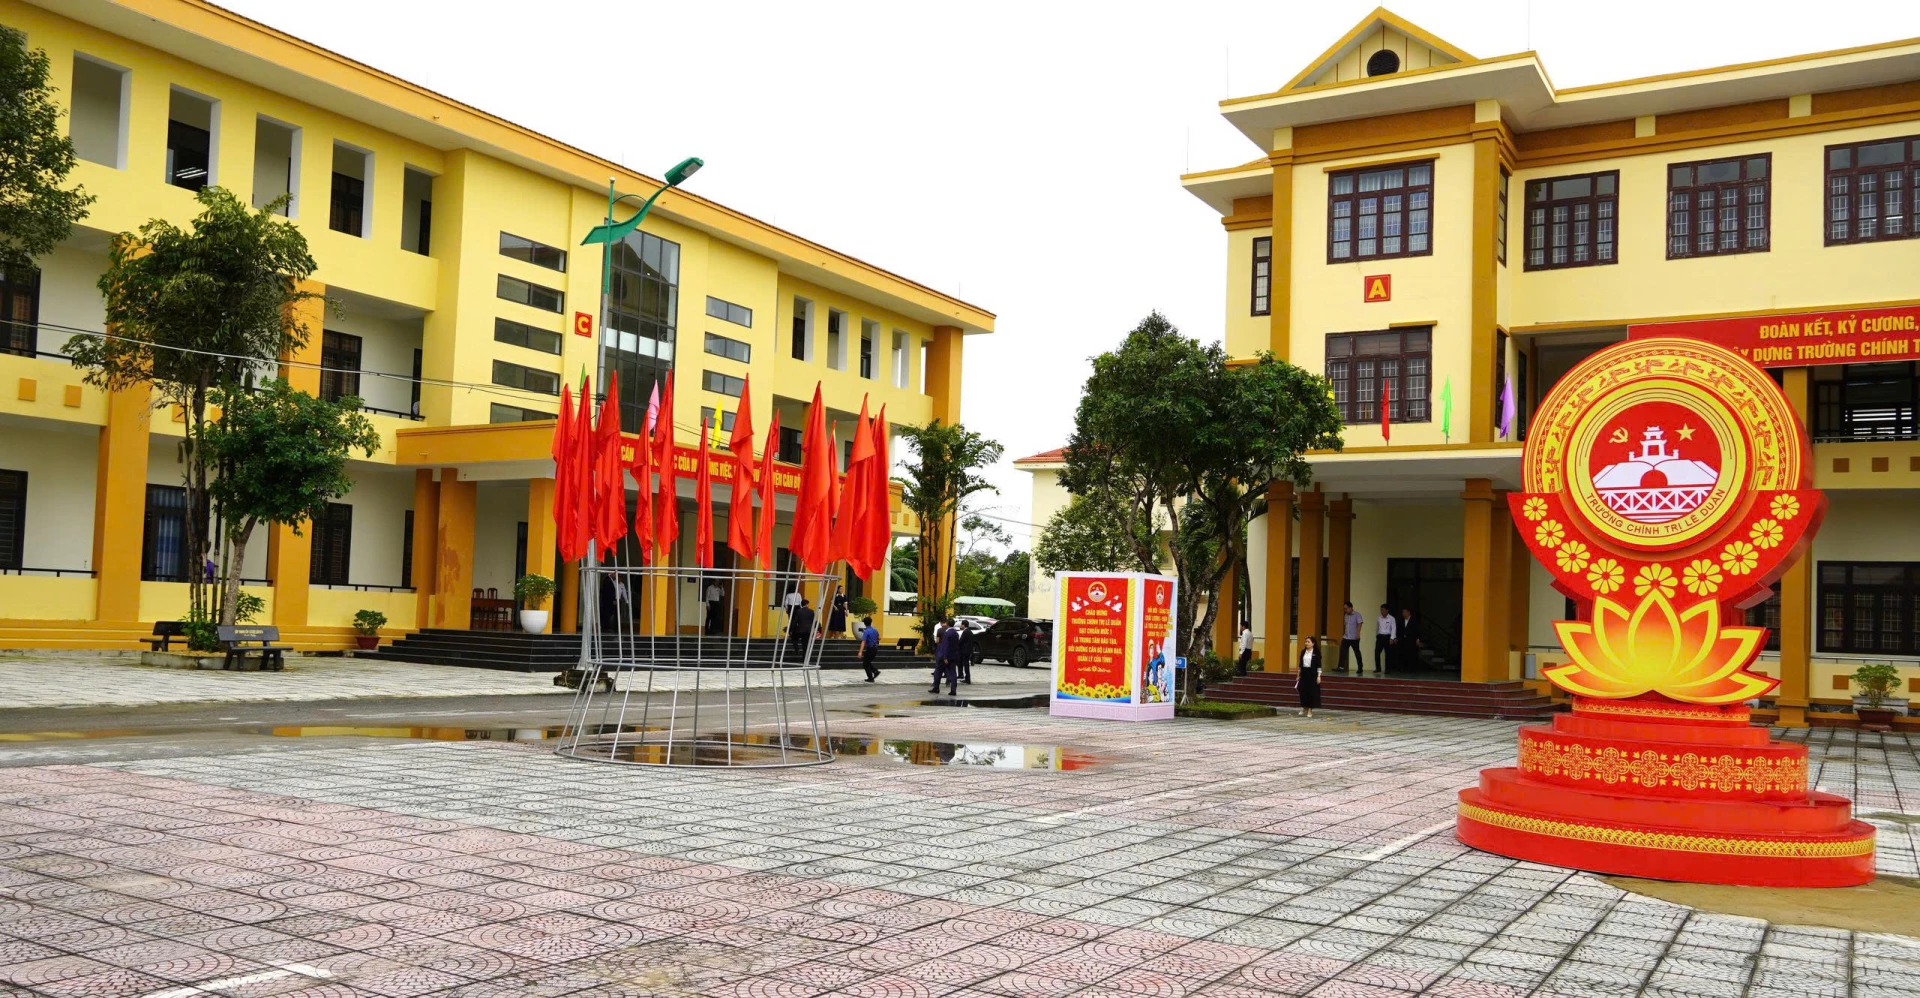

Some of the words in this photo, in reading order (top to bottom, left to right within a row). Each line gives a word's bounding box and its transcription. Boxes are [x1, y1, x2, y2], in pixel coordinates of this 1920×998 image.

[1368, 279, 1387, 298] A
[578, 316, 589, 333] C
[1760, 321, 1799, 339] ĐOÀN
[1804, 317, 1833, 336] KẾT,
[1838, 314, 1857, 334] KỶ
[1861, 315, 1919, 332] CƯƠNG,
[1753, 346, 1792, 364] DỰNG
[1797, 340, 1856, 359] TRƯỜNG
[1861, 337, 1908, 356] CHÍNH
[1587, 493, 1623, 527] TRƯỜNG
[1627, 524, 1659, 534] CHÍNH
[1664, 523, 1683, 532] TRỊ
[1685, 514, 1699, 526] LÊ
